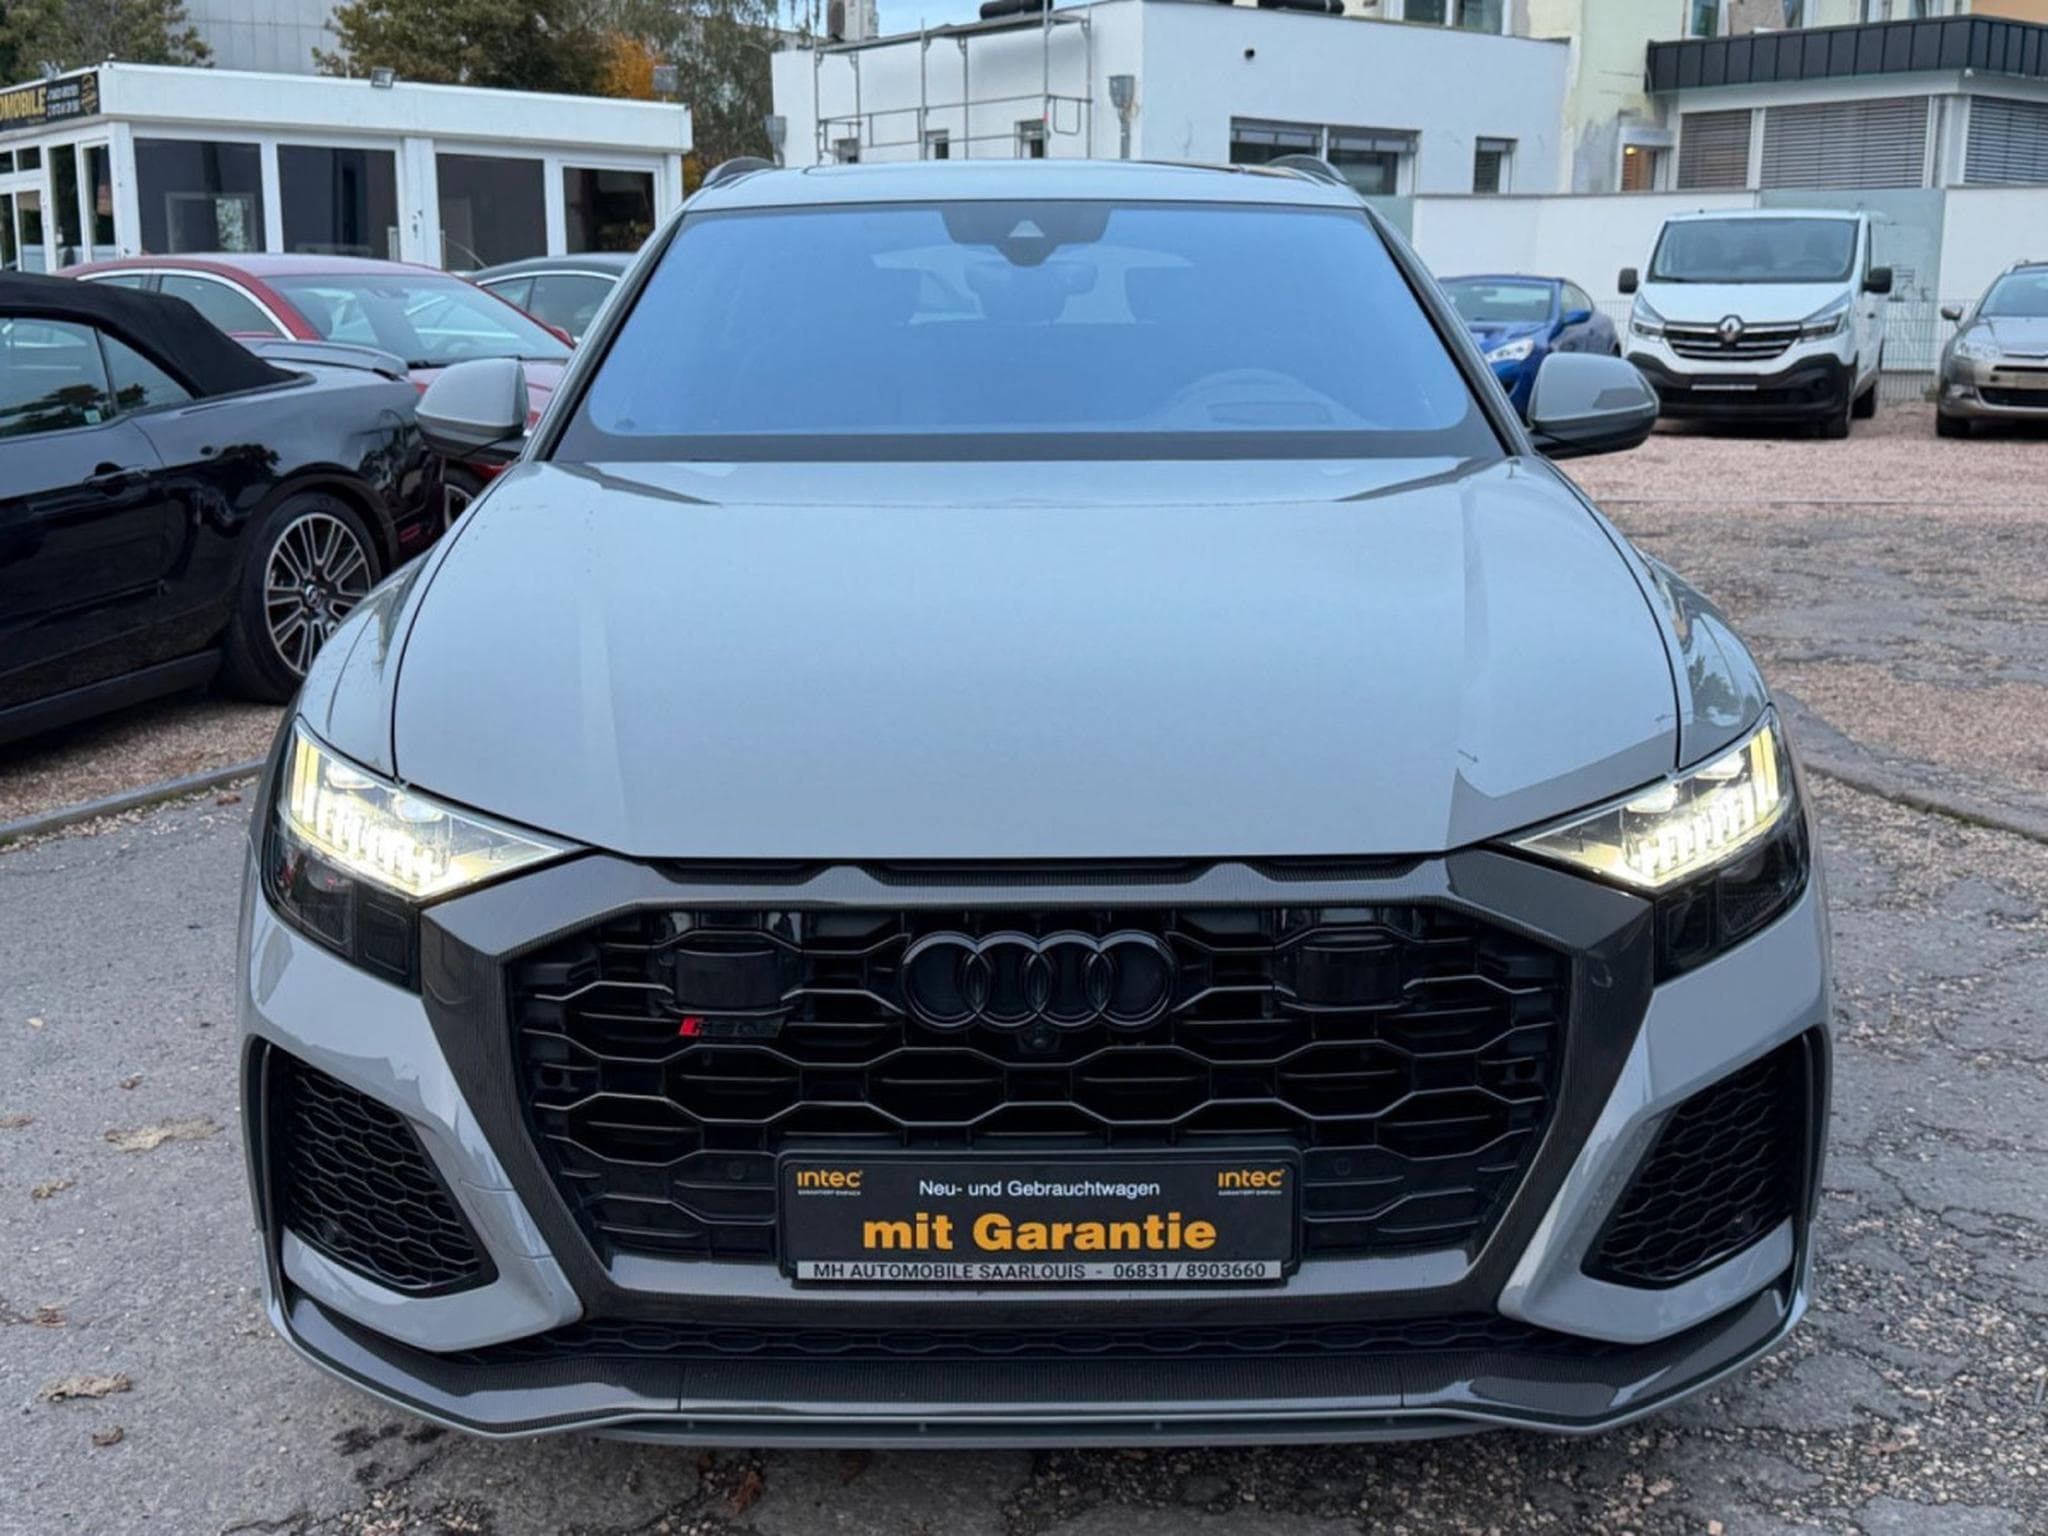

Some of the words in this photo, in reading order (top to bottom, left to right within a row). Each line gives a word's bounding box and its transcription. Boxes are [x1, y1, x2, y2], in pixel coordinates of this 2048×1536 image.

[797, 1170, 860, 1188] intec
[1217, 1169, 1281, 1188] intec
[919, 1180, 963, 1197] Neu-
[968, 1180, 1002, 1197] und
[1007, 1180, 1161, 1200] Gebrauchtwagen
[862, 1212, 954, 1251] mit
[971, 1211, 1217, 1252] Garantie
[813, 1263, 845, 1279] MH
[849, 1263, 974, 1279] AUTOMOBILE
[978, 1263, 1086, 1280] SAARLOUIS
[1112, 1263, 1168, 1279] 06831
[1185, 1263, 1266, 1279] 8903660
